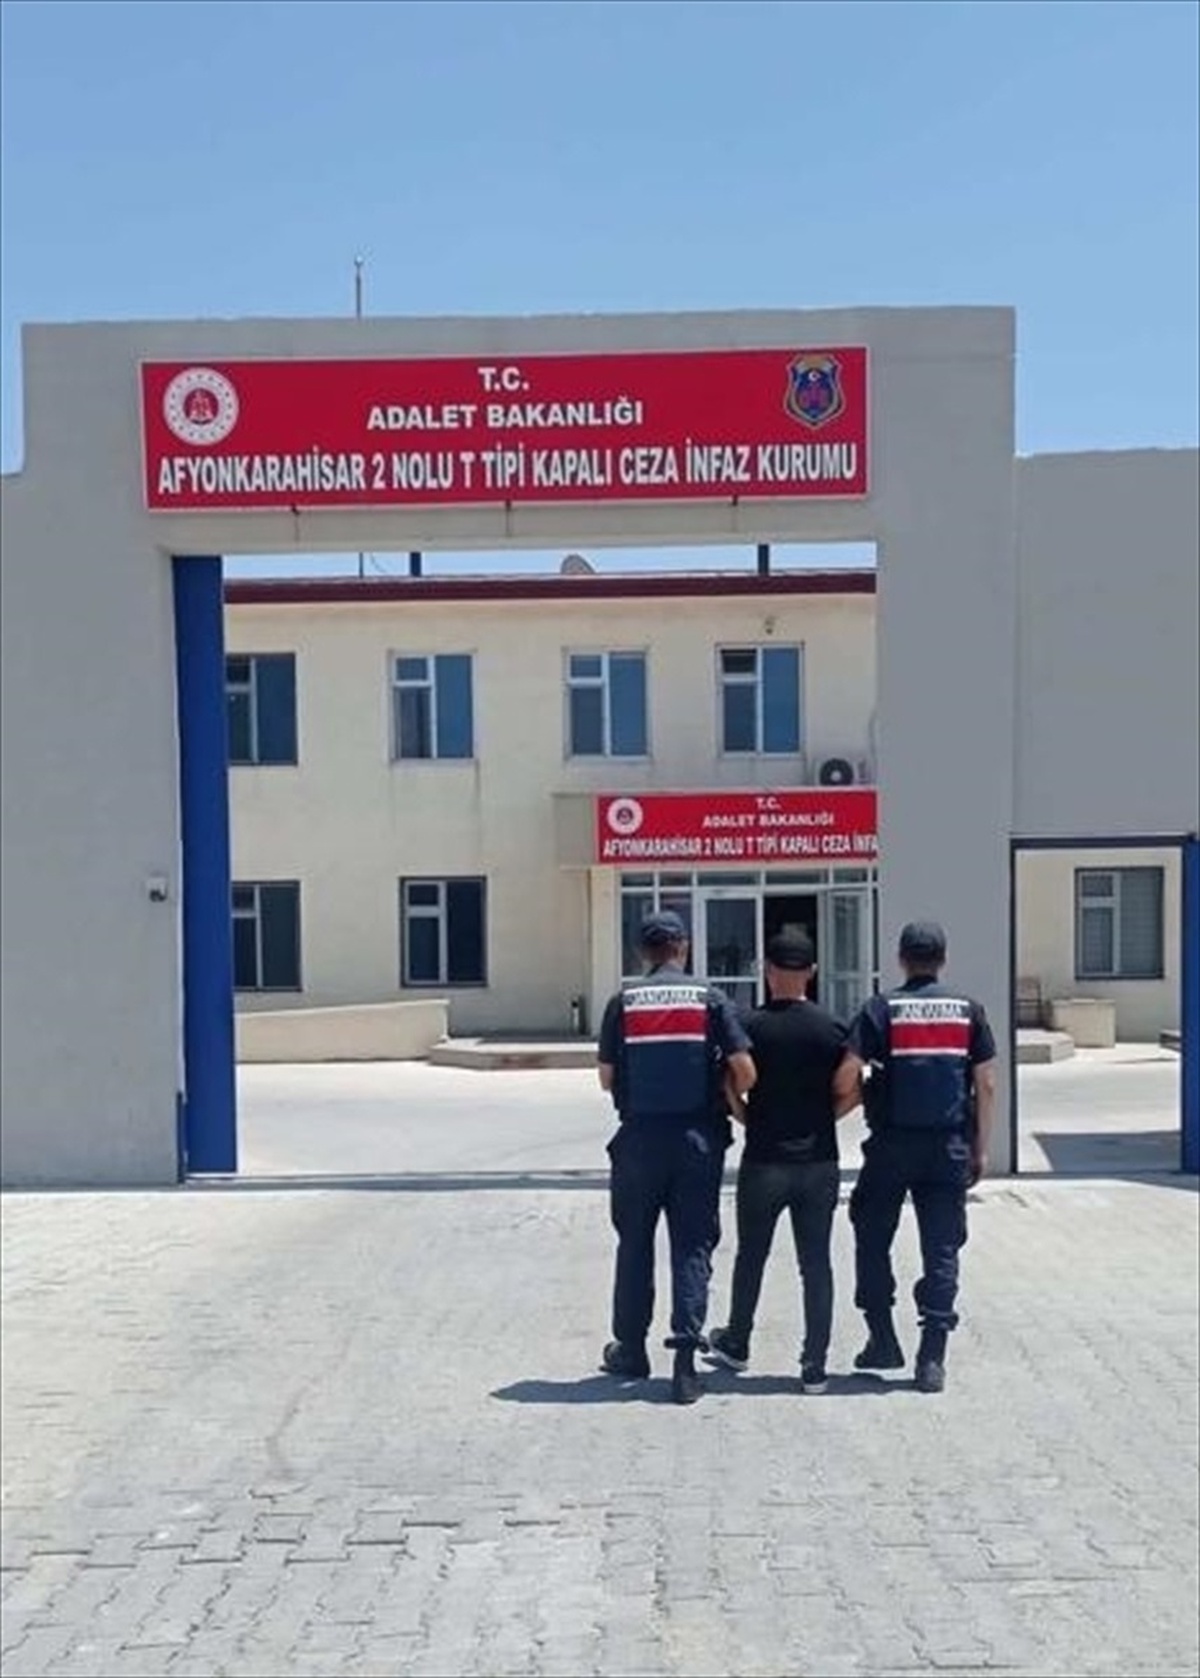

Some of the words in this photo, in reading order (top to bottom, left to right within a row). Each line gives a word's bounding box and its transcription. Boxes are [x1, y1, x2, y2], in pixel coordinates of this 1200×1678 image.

[478, 367, 530, 391] T.C.
[367, 405, 478, 430] ADALET
[486, 396, 643, 428] BAKANLIĞI
[158, 444, 367, 494] AFYONKARAHİSAR
[372, 453, 386, 490] 2
[392, 452, 453, 489] NOLU
[459, 452, 478, 489] T
[480, 443, 525, 488] TİPİ
[531, 446, 613, 487] KAPALI
[618, 446, 679, 485] CEZA
[685, 438, 752, 484] İNFAZ
[757, 443, 858, 482] KURUMU
[756, 797, 781, 810] T.C.
[702, 813, 755, 828] ADALET
[759, 811, 835, 827] BAKANLIĞI
[704, 837, 712, 856] 2
[714, 836, 744, 855] NOLU
[746, 837, 755, 854] T
[756, 832, 778, 854] TİPİ
[780, 835, 820, 853] KAPALI
[822, 833, 851, 853] CEZA
